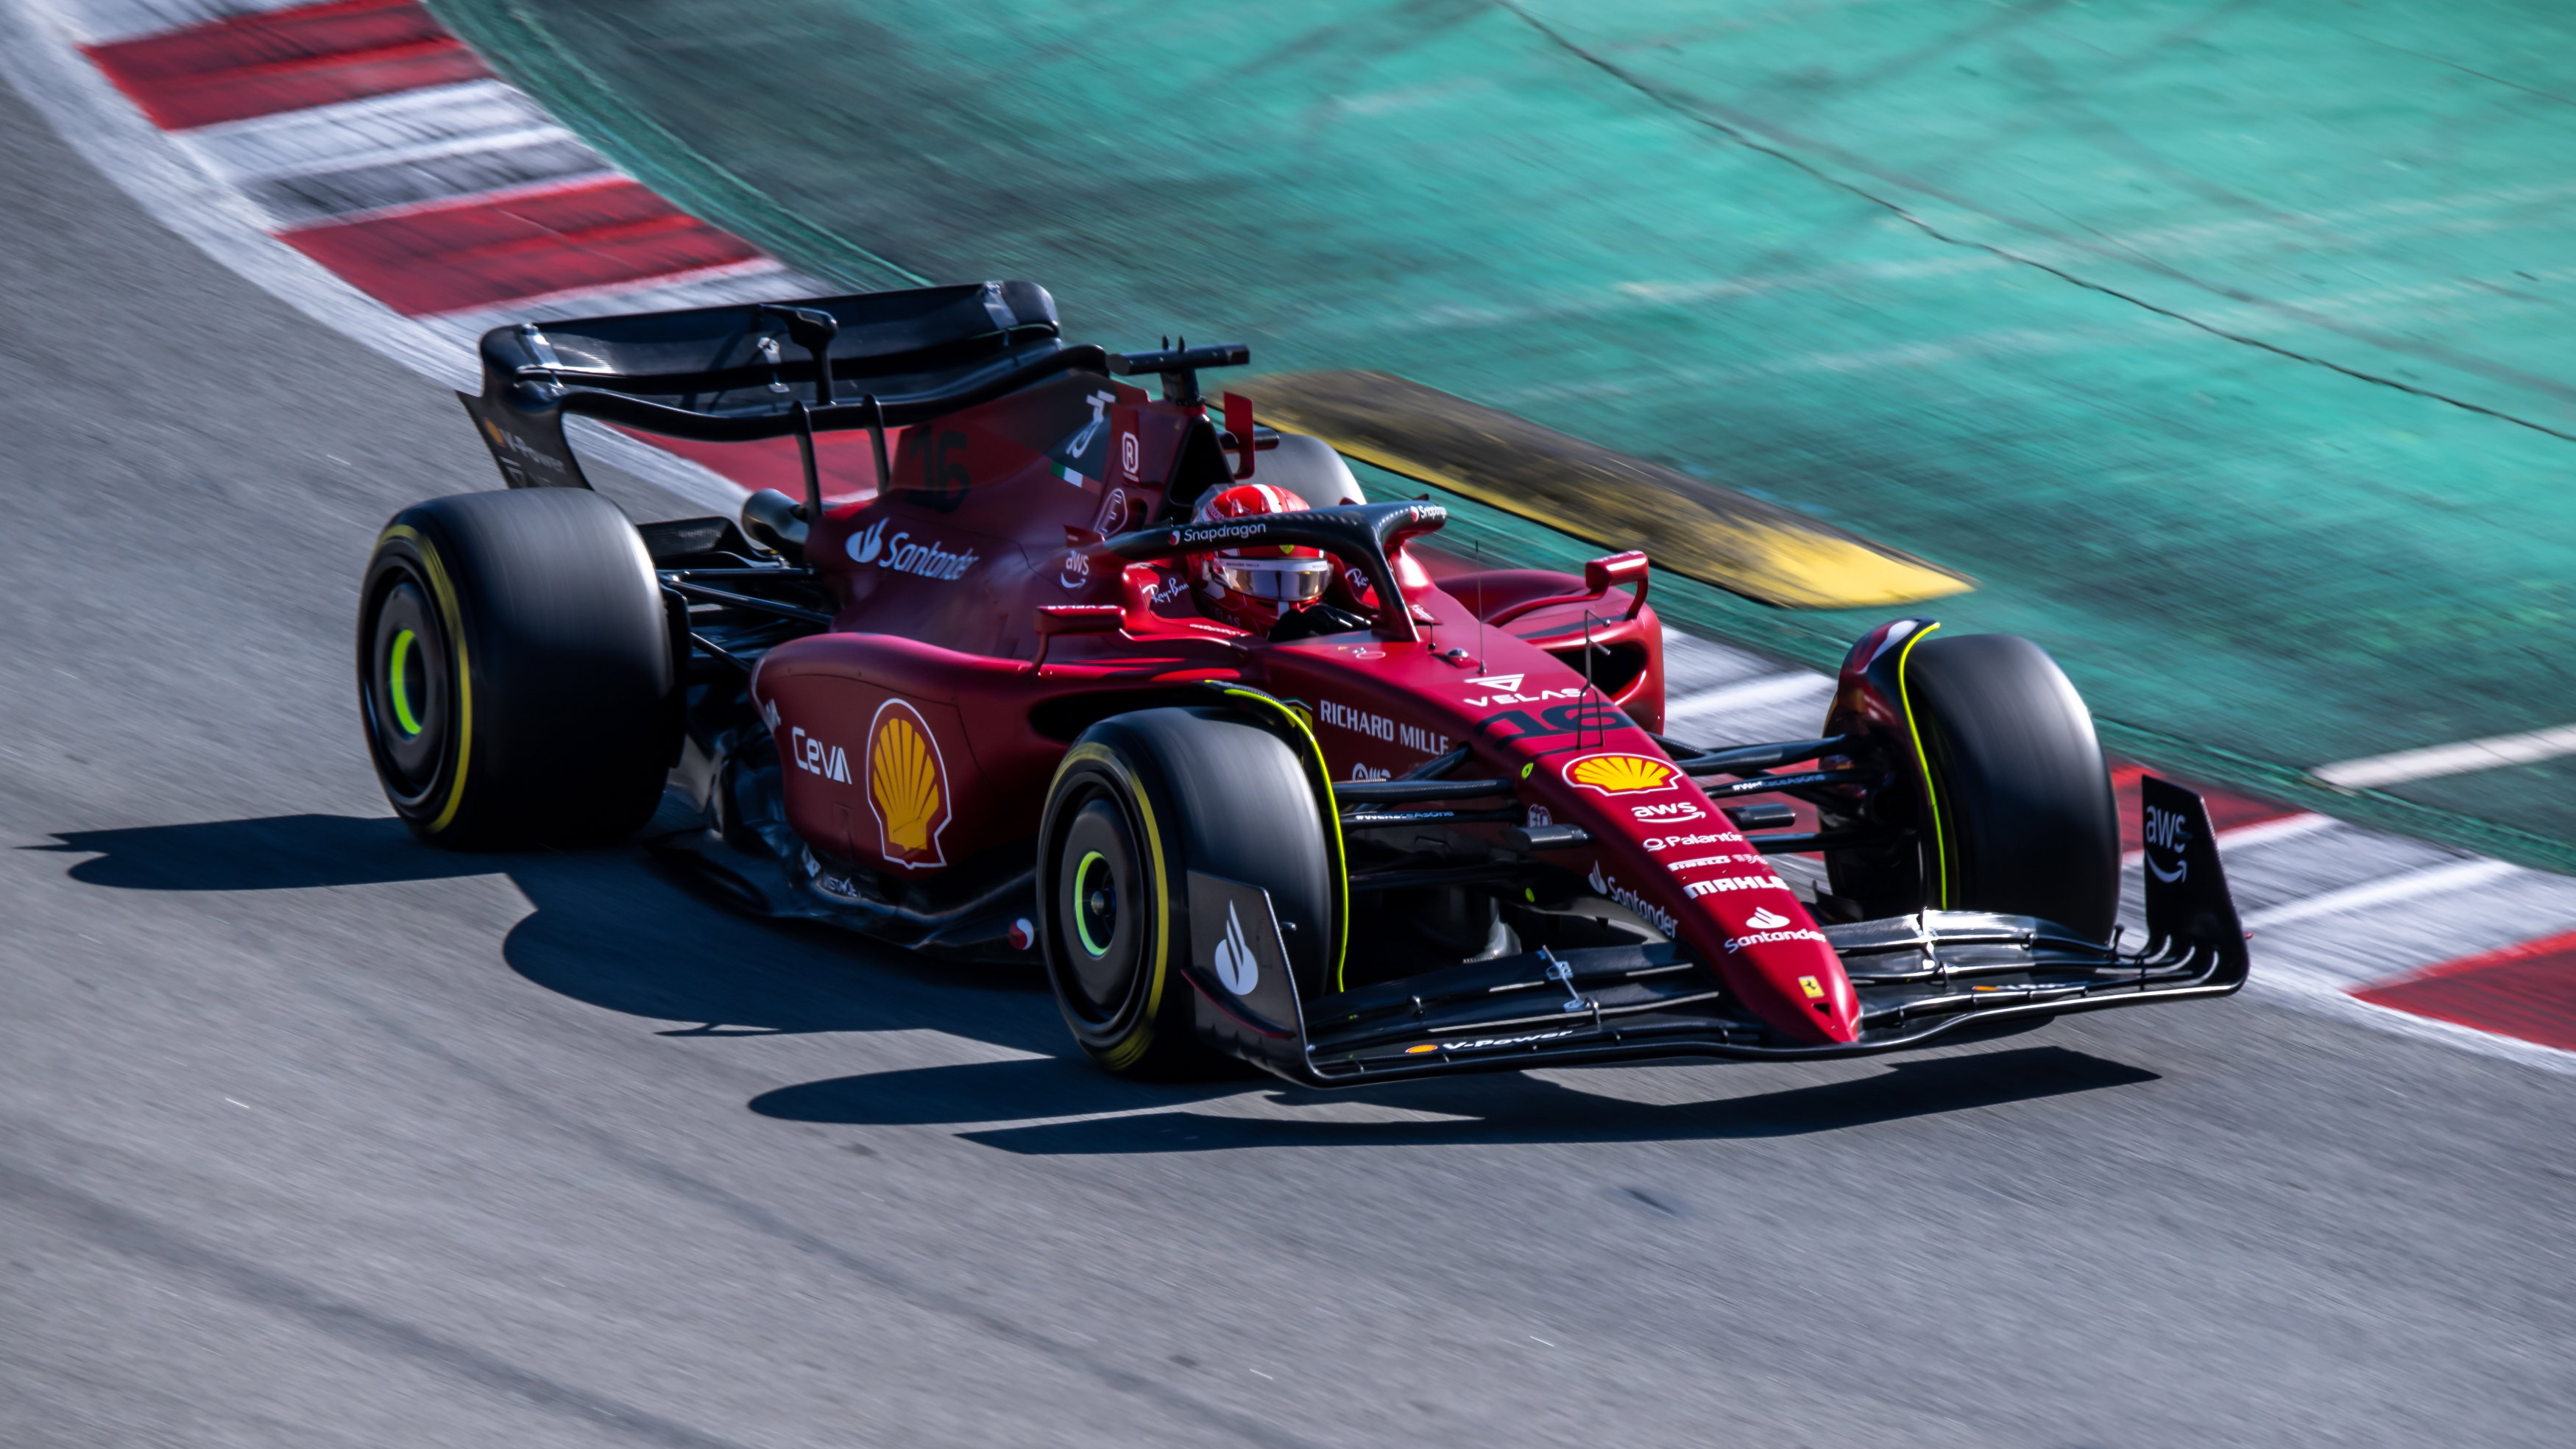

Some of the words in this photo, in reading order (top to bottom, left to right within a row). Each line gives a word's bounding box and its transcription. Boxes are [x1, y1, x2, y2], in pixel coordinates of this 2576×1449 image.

[903, 425, 971, 514] 16
[1183, 523, 1266, 542] Snapdragon
[878, 532, 980, 581] Santander
[1065, 550, 1089, 575] aws
[1142, 577, 1189, 603] Ray-Ban
[1463, 688, 1586, 707] VELAS
[1320, 700, 1394, 742] RICHARD
[1474, 702, 1641, 751] 16
[1631, 802, 1697, 818] aws
[1665, 832, 1743, 847] Palantir
[2146, 805, 2186, 854] aws
[1607, 876, 1679, 939] Santander
[1724, 928, 1827, 954] Santander
[1443, 1030, 1573, 1050] V-Power
